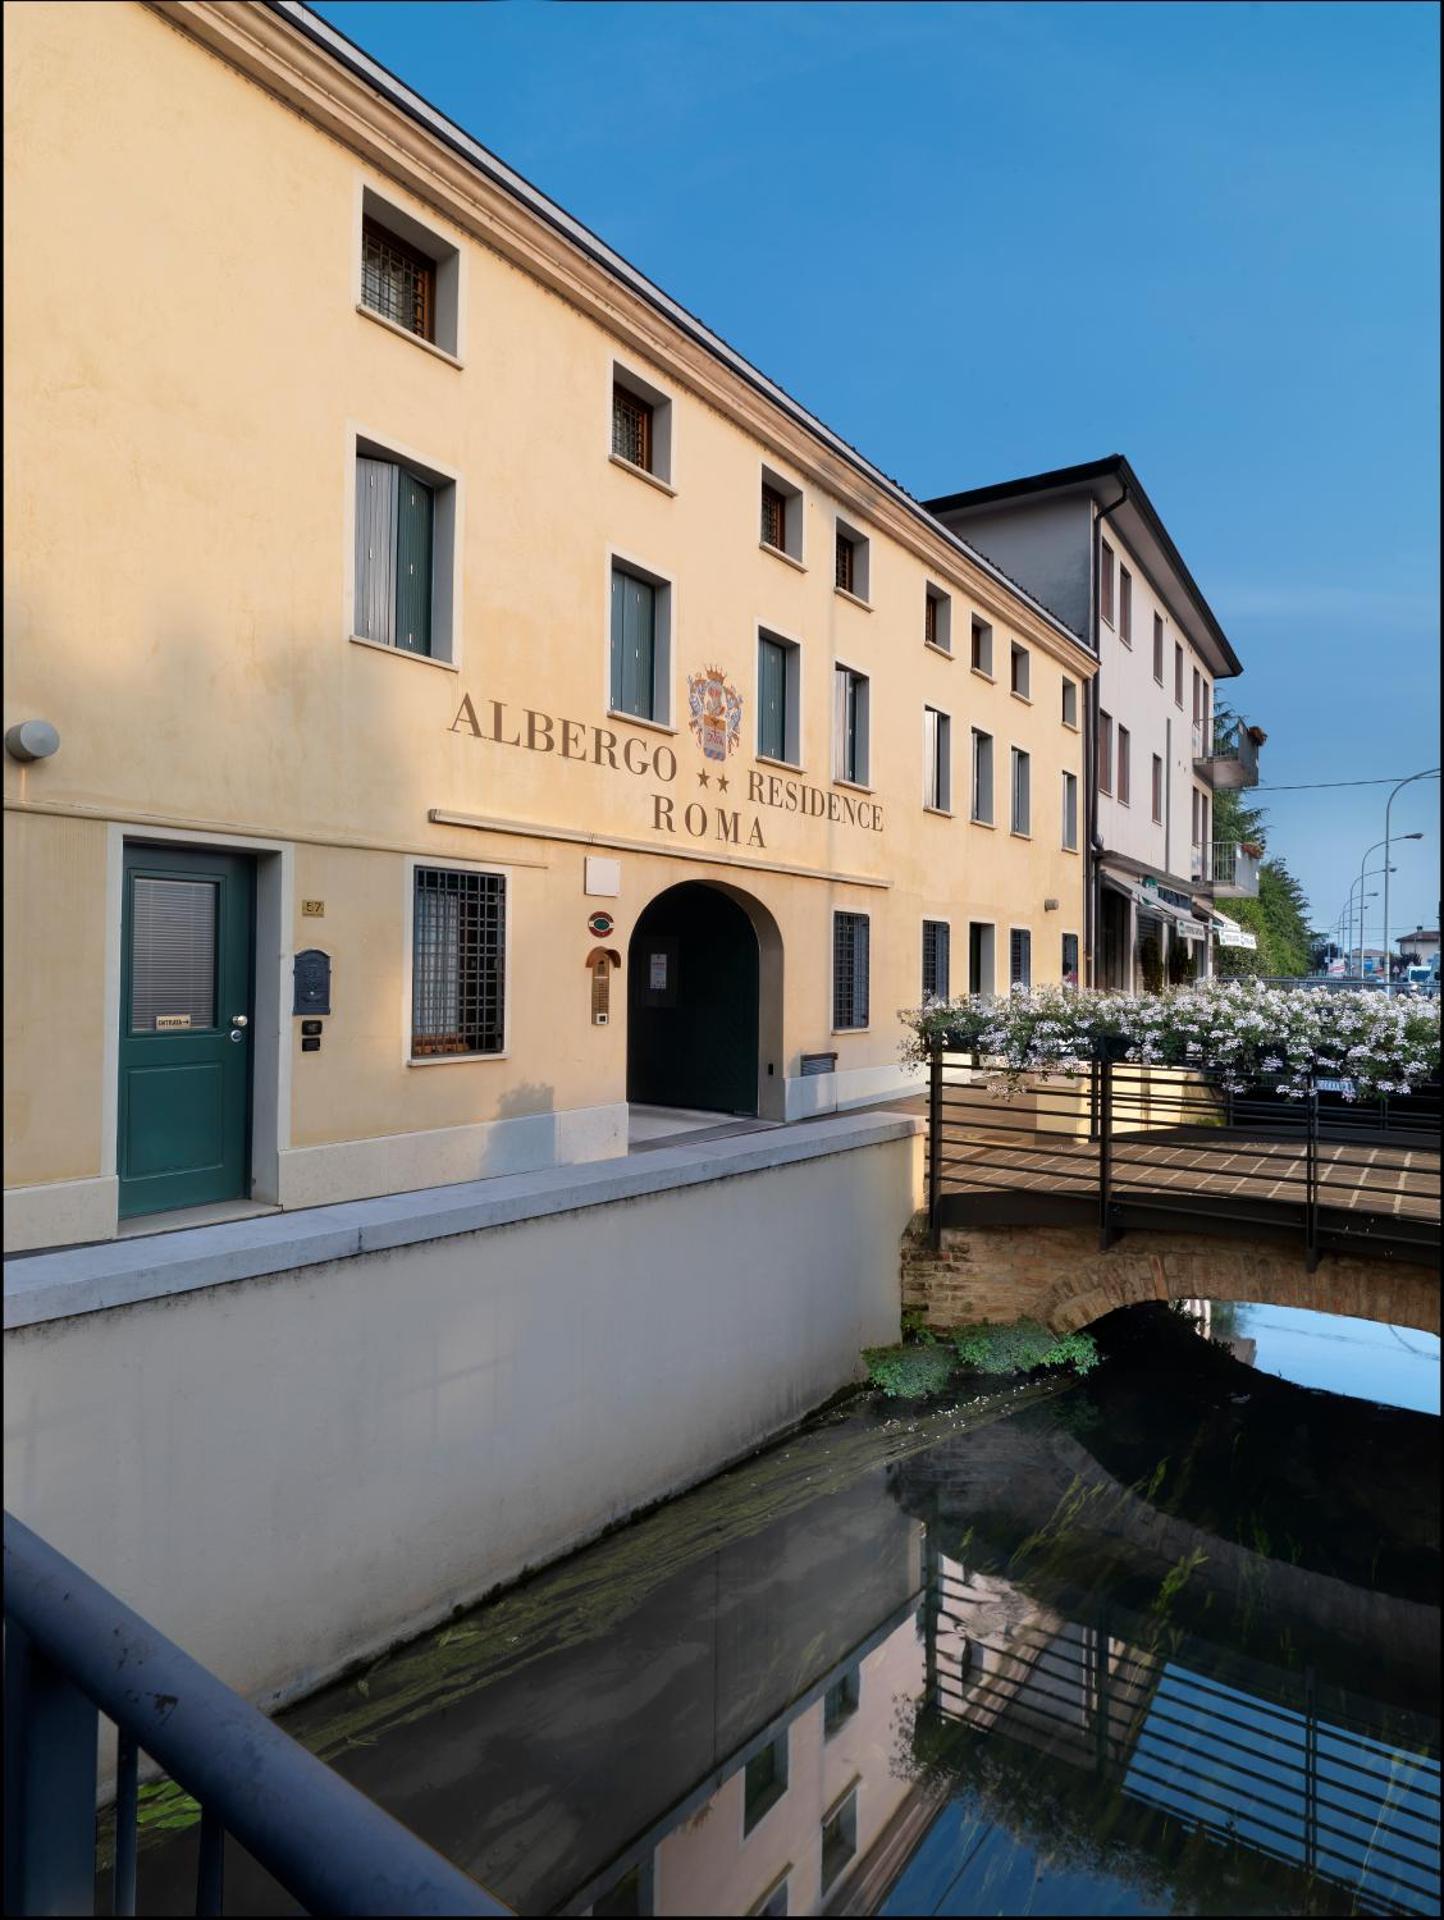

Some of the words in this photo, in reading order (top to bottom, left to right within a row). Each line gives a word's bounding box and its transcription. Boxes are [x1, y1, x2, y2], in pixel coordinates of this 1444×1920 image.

[447, 692, 678, 783] ALBERGO
[747, 770, 884, 833] RESIDENCE
[650, 794, 767, 849] ROMA
